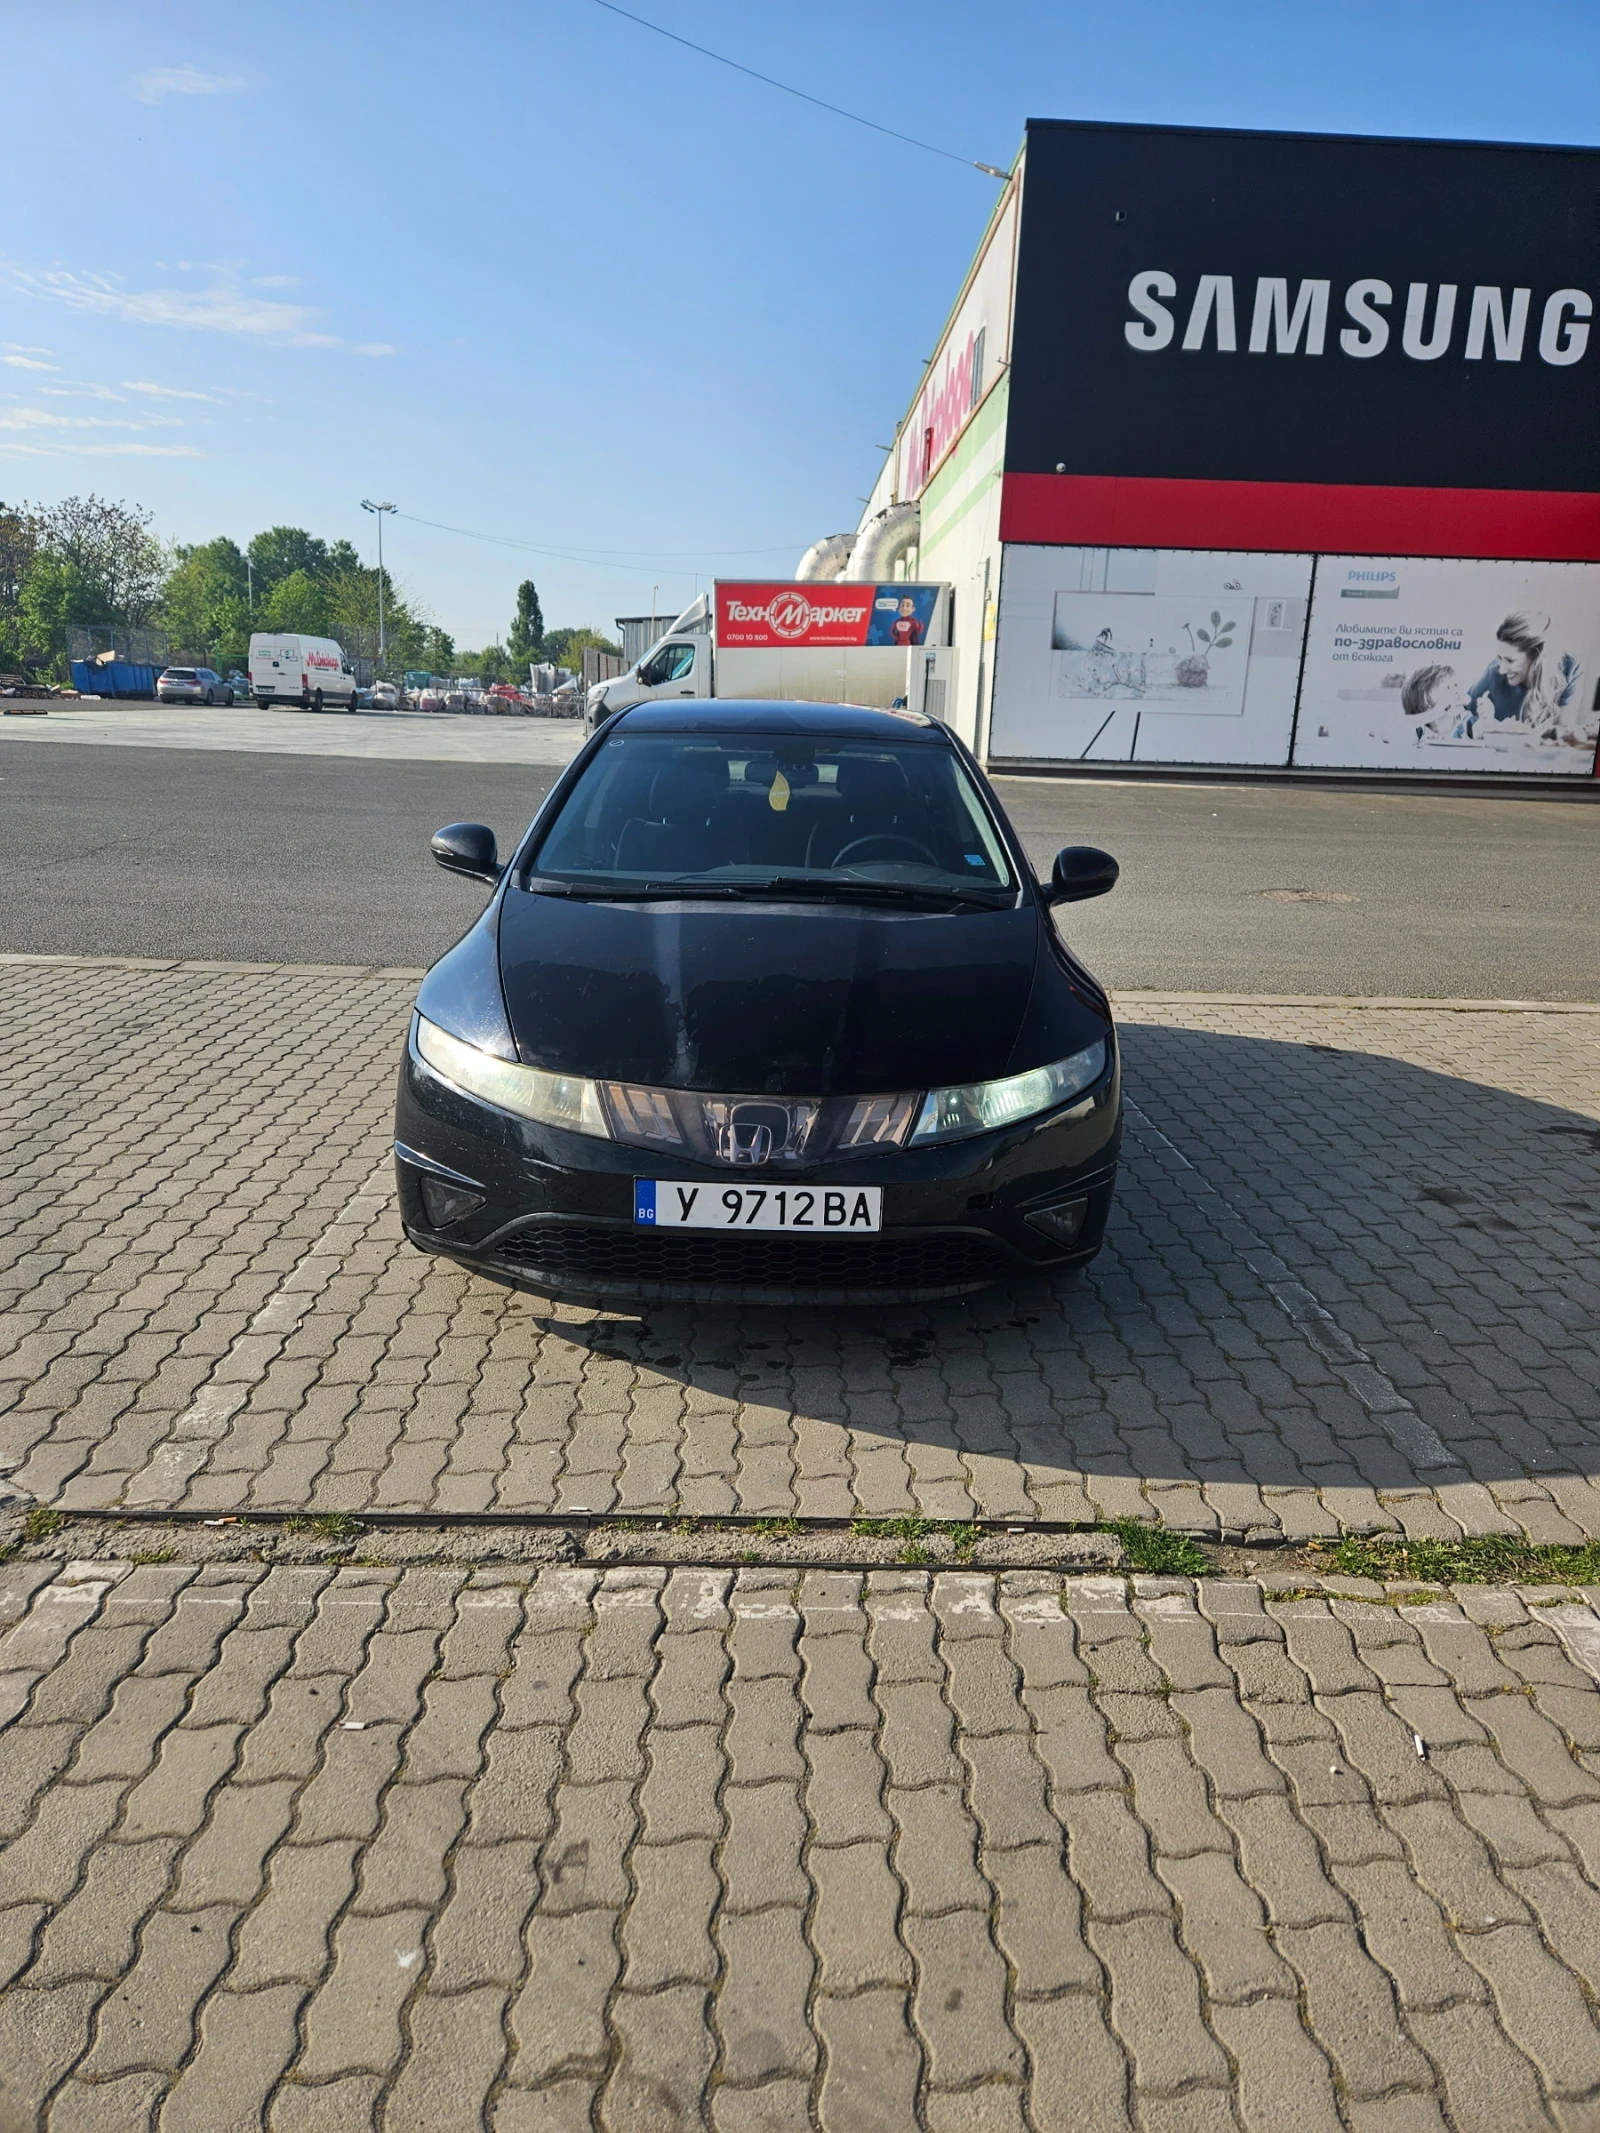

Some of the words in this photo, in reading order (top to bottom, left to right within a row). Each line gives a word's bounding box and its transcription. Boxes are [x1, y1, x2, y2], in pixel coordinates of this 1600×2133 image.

[1124, 270, 1594, 366] SAMSUNG
[1348, 570, 1397, 582] PHILIPS
[1335, 623, 1397, 635] Любимите
[1399, 625, 1412, 635] ви
[1414, 627, 1449, 636] ястия
[1450, 629, 1464, 637] са
[1334, 636, 1462, 650] по-здравословни
[1332, 653, 1349, 661] от
[1351, 652, 1394, 662] всякога
[638, 1208, 654, 1219] BG
[721, 1189, 872, 1227] 9712BA
